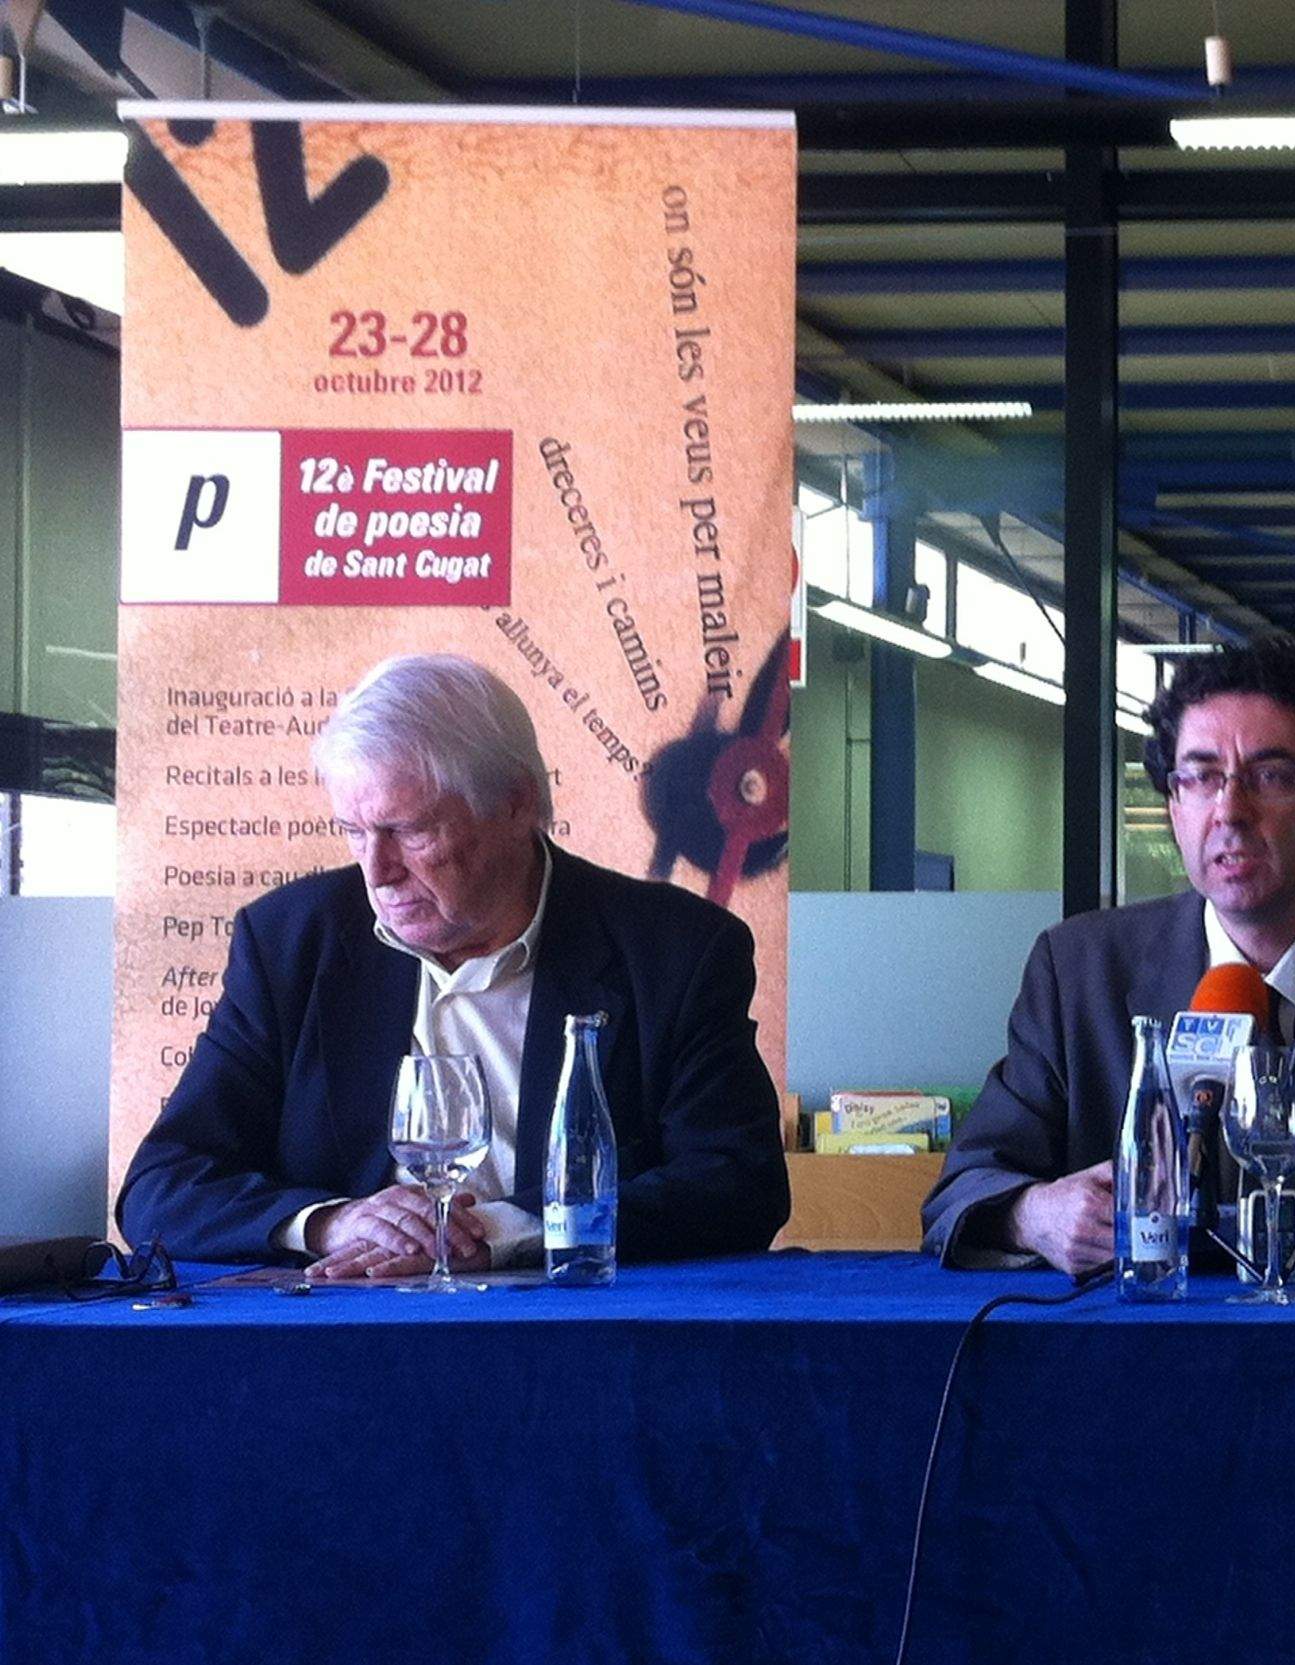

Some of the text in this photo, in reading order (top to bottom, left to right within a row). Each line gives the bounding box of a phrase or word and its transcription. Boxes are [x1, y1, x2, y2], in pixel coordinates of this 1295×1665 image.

[329, 310, 468, 357] 23-28
[314, 368, 483, 394] octubre 2012
[662, 185, 743, 699] on són les veus per maleir
[300, 457, 500, 494] 12è Festival
[174, 473, 230, 551] p
[314, 503, 482, 546] de poesia
[304, 549, 491, 583] de Sant Cugat
[538, 437, 667, 713] dreceres i camins
[495, 612, 565, 690] allunya
[562, 687, 591, 713] el
[167, 686, 338, 712] Inauguració a la
[166, 714, 199, 736] del
[166, 764, 253, 786] Recitals
[259, 769, 271, 786] a
[278, 765, 308, 786] les
[165, 815, 281, 841] Espectacle
[164, 866, 235, 886] Poesia
[243, 869, 254, 886] a
[163, 915, 204, 941] Pep
[161, 966, 219, 992] After
[161, 996, 188, 1016] de
